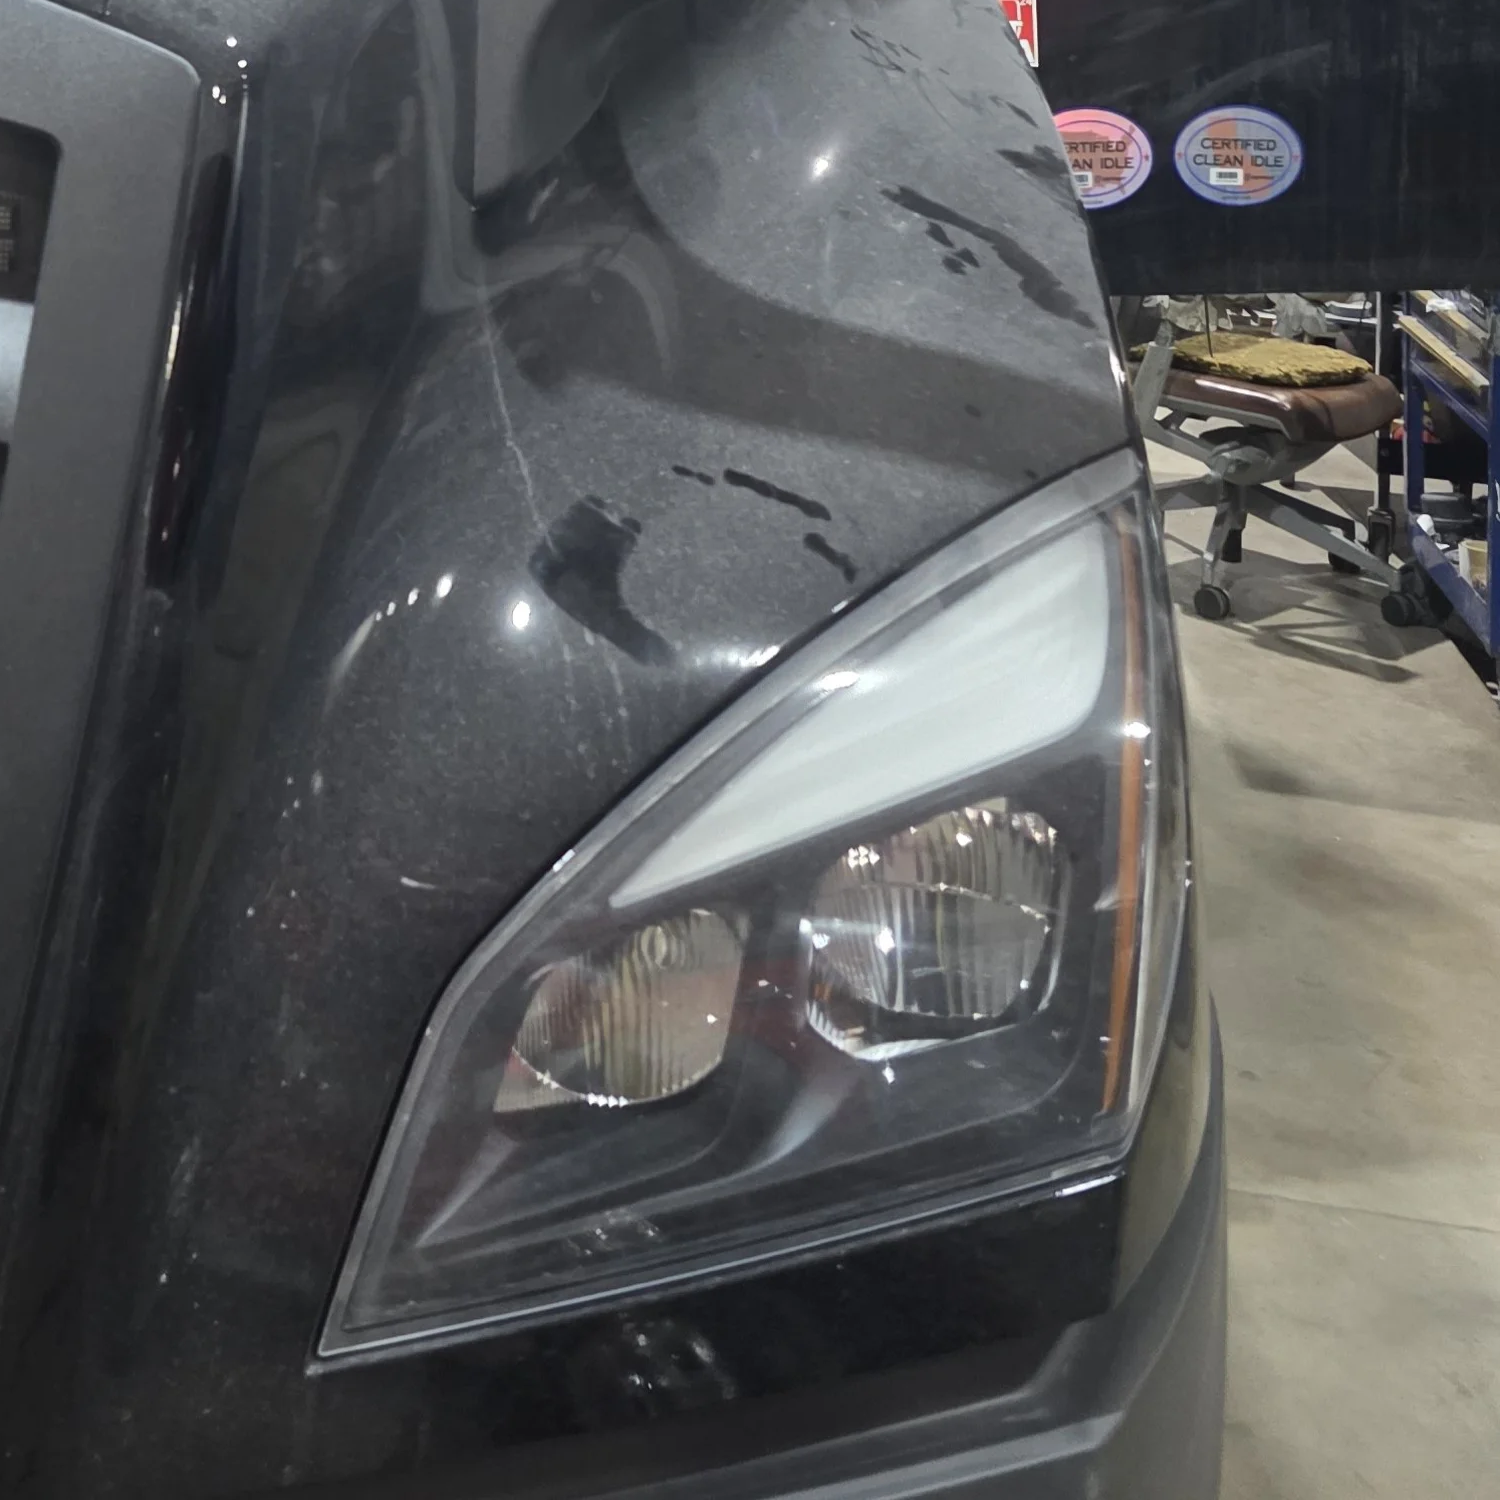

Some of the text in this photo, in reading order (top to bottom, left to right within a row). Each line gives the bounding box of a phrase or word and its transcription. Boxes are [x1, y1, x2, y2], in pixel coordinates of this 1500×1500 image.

[1064, 140, 1127, 154] RTIFIED
[1200, 137, 1278, 152] CERTIFIED
[1100, 157, 1135, 169] IDLE
[1192, 153, 1286, 168] CLEAN IDLE
